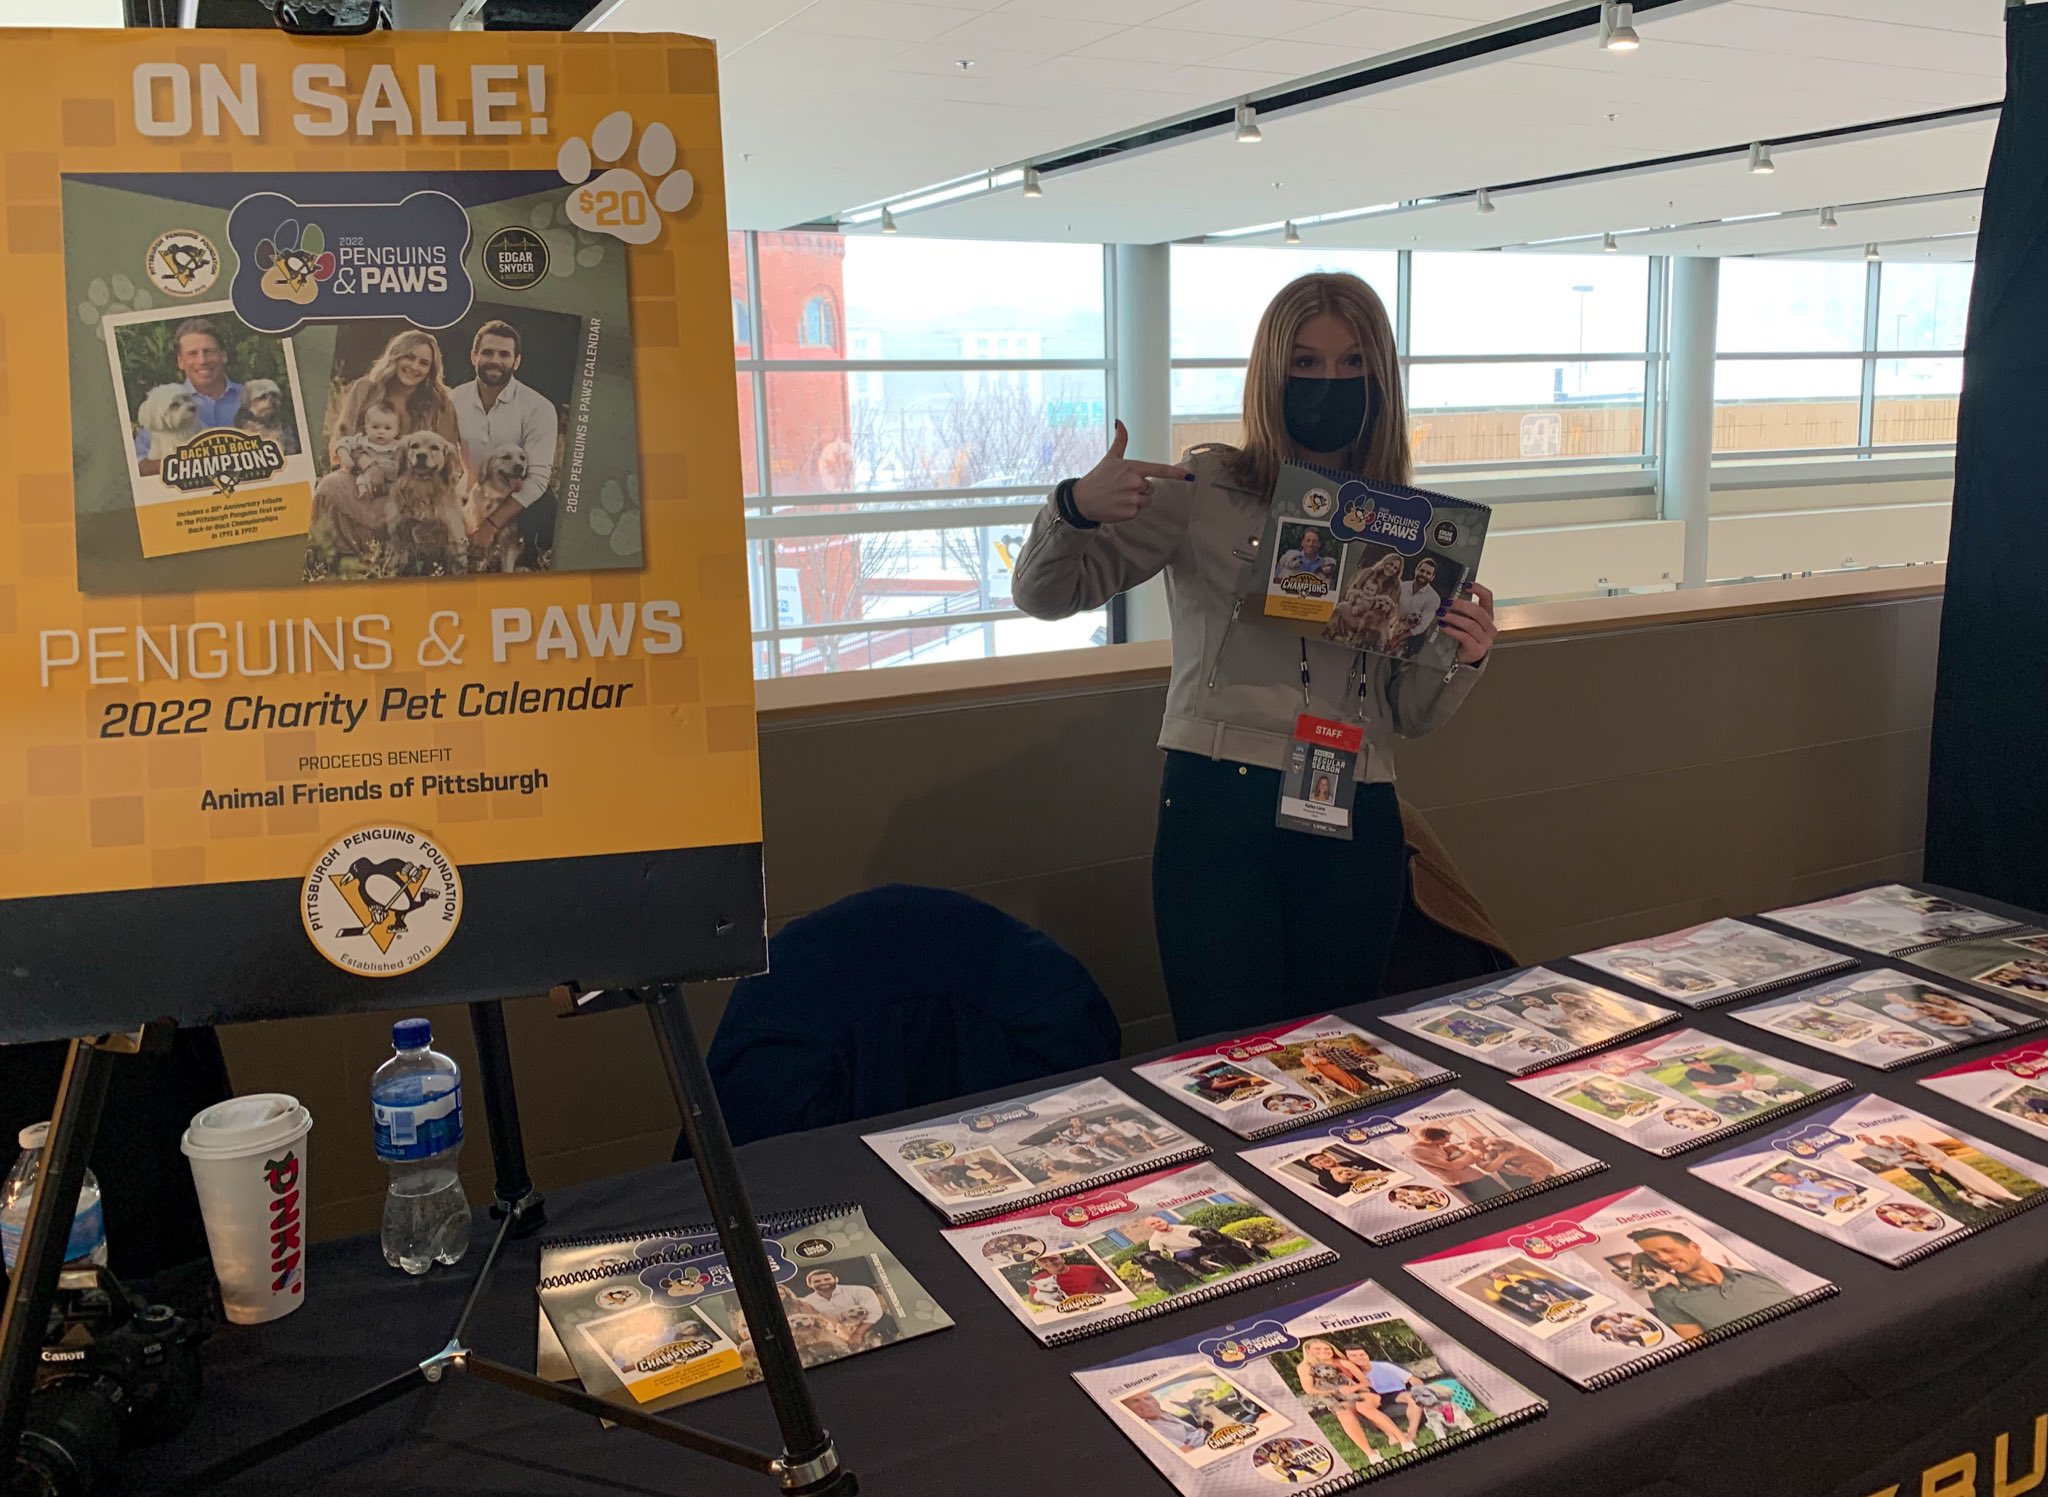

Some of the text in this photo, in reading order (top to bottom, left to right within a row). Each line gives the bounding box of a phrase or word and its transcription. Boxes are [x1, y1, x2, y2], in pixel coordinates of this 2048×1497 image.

[133, 62, 548, 137] ON SALE!
[578, 189, 647, 227] $20
[338, 236, 364, 247] 2022
[339, 246, 447, 266] PENGUINS
[498, 251, 533, 264] EDGAR
[499, 263, 535, 273] SNYDER
[333, 265, 449, 295] & PAWS
[566, 317, 602, 513] 2022 PENGUINS & PAWS CALENDAR
[180, 439, 260, 460] BACK TO BACK
[167, 444, 280, 482] CHAMPIONS
[177, 509, 204, 518] Includes
[223, 500, 261, 510] Anniversary
[262, 496, 283, 504] tribute
[195, 513, 229, 524] Pittsburgh
[229, 509, 258, 518] Penguins
[231, 515, 279, 527] Championships
[1377, 511, 1421, 530] PENGUINS
[1370, 521, 1419, 542] & PAWS
[1281, 579, 1328, 594] CHAMPIONS
[39, 599, 684, 688] PENGUINS & PAWS
[99, 677, 634, 739] 2022 Charity Pet Calendar
[1314, 725, 1344, 739] STAFF
[298, 748, 453, 771] PROCEEDS BENEFIT
[1311, 762, 1341, 774] SEASON
[1312, 755, 1346, 769] REGULAR
[200, 768, 549, 811] Animal Friends of Pittsburgh
[307, 828, 456, 931] PITTSBURGH PENGUINS FOUNDATION
[339, 944, 433, 972] Established 2010
[1419, 1107, 1476, 1122] Matheson
[1155, 1187, 1217, 1209] Ruhwedel
[1615, 1208, 1673, 1225] DeSmith
[1319, 1310, 1393, 1330] Friedman
[143, 1343, 162, 1354] EOS
[1254, 1334, 1288, 1351] PAWS
[41, 1350, 85, 1362] Canon
[639, 1340, 711, 1372] CHAMPIONS
